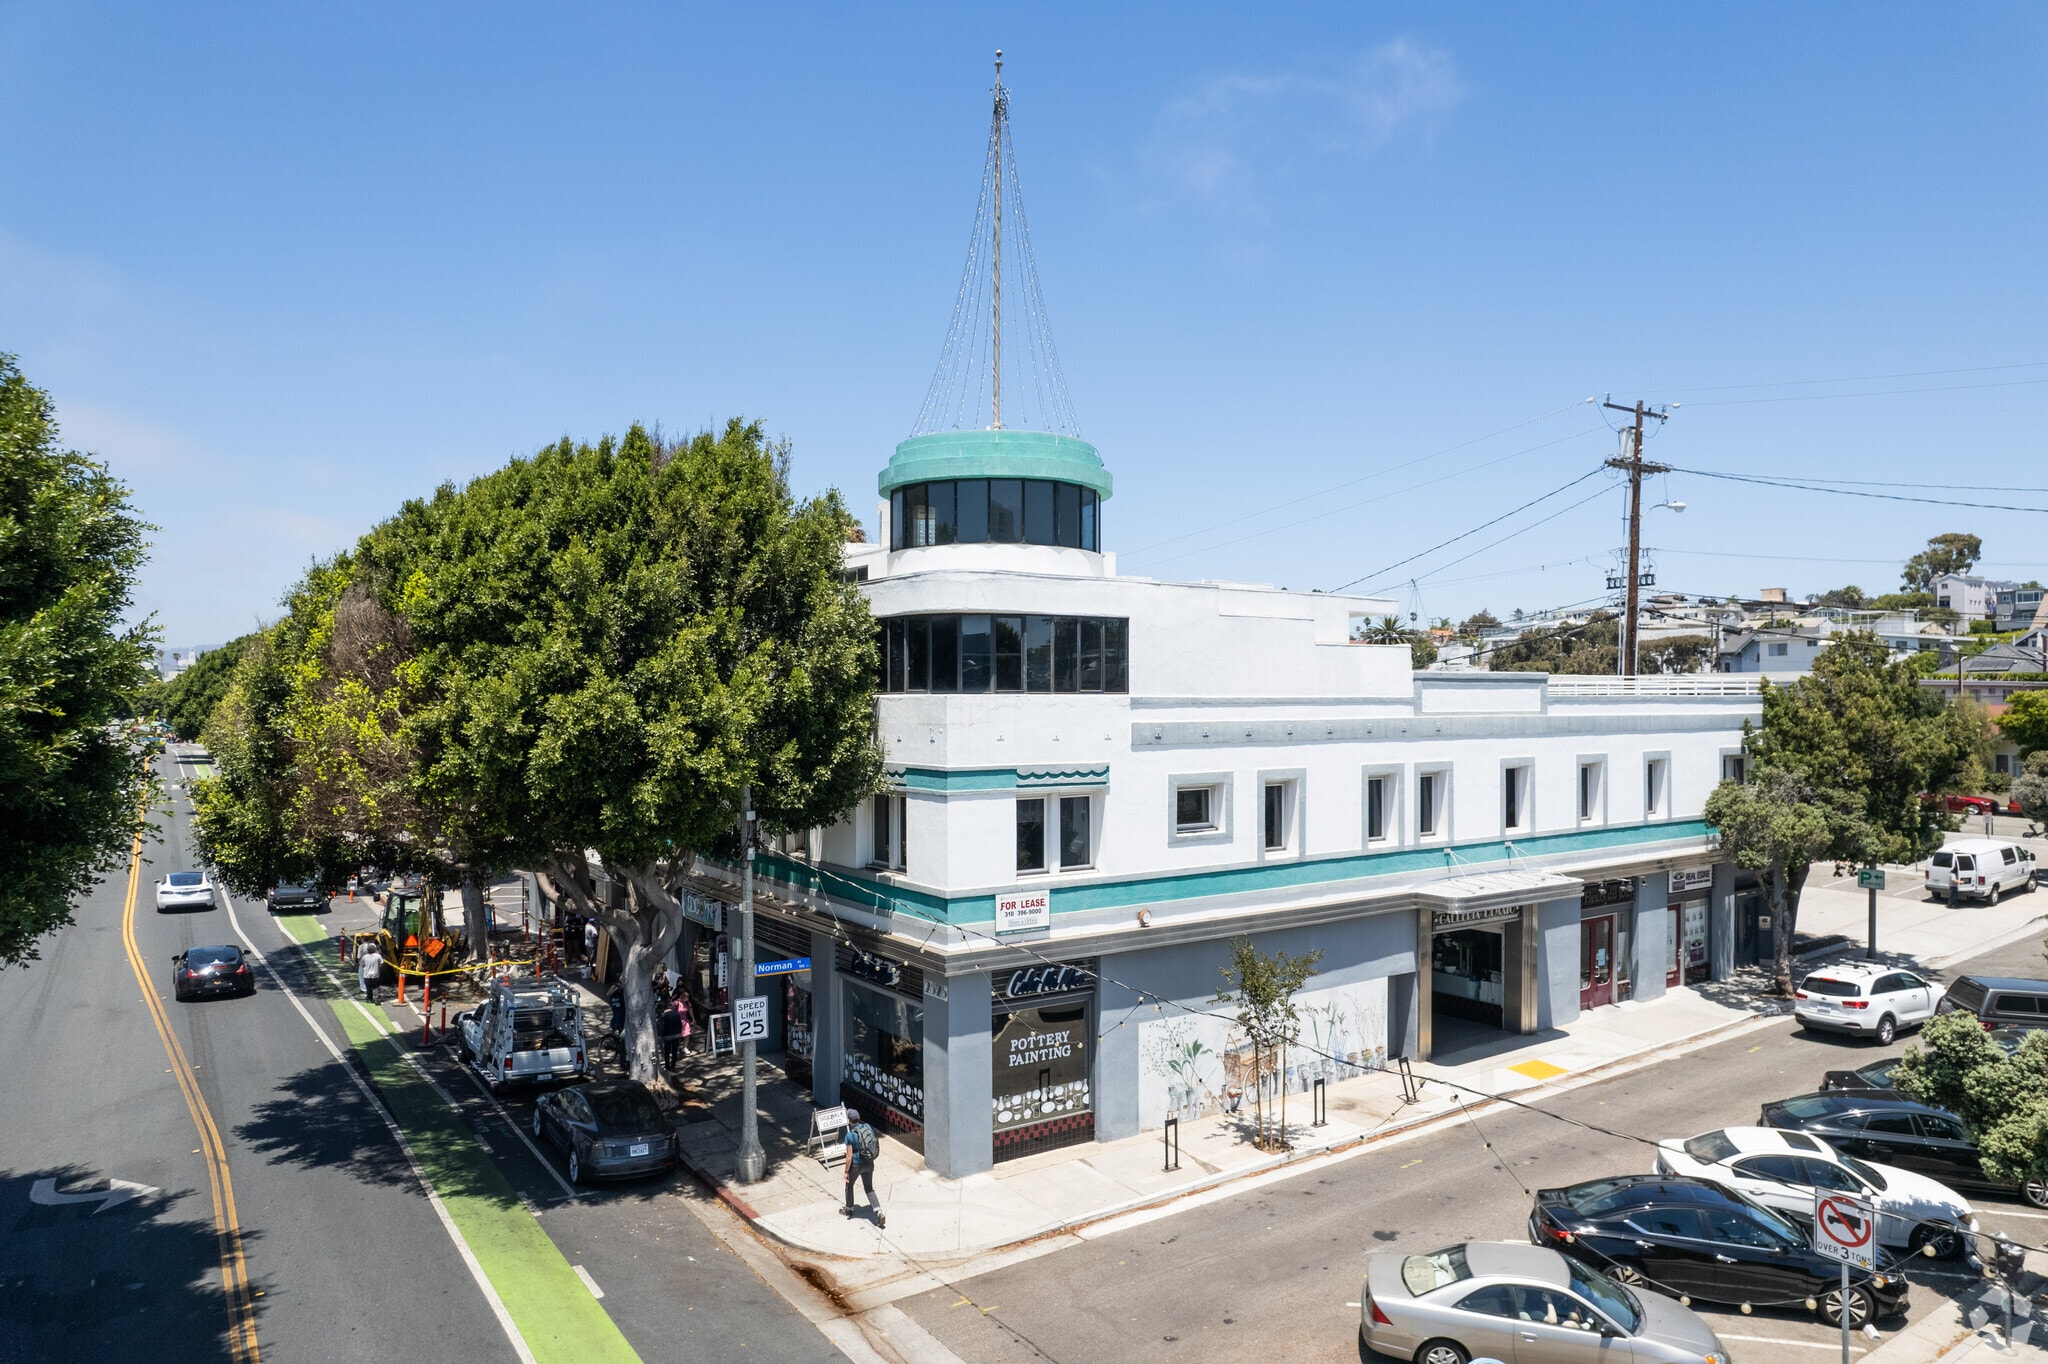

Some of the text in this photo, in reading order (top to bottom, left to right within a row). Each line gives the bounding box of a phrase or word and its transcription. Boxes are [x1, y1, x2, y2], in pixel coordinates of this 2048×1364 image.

[1861, 872, 1872, 884] P
[1000, 898, 1046, 911] FOR LEASE
[1017, 908, 1042, 917] 396-9000
[758, 962, 793, 972] Norman
[738, 1001, 765, 1011] SPEED
[741, 1010, 762, 1019] LIMIT
[740, 1019, 764, 1037] 25
[1010, 1030, 1070, 1052] POTTERY
[1008, 1044, 1072, 1067] PAINTING
[1817, 1241, 1873, 1266] OVER 3 TONS
